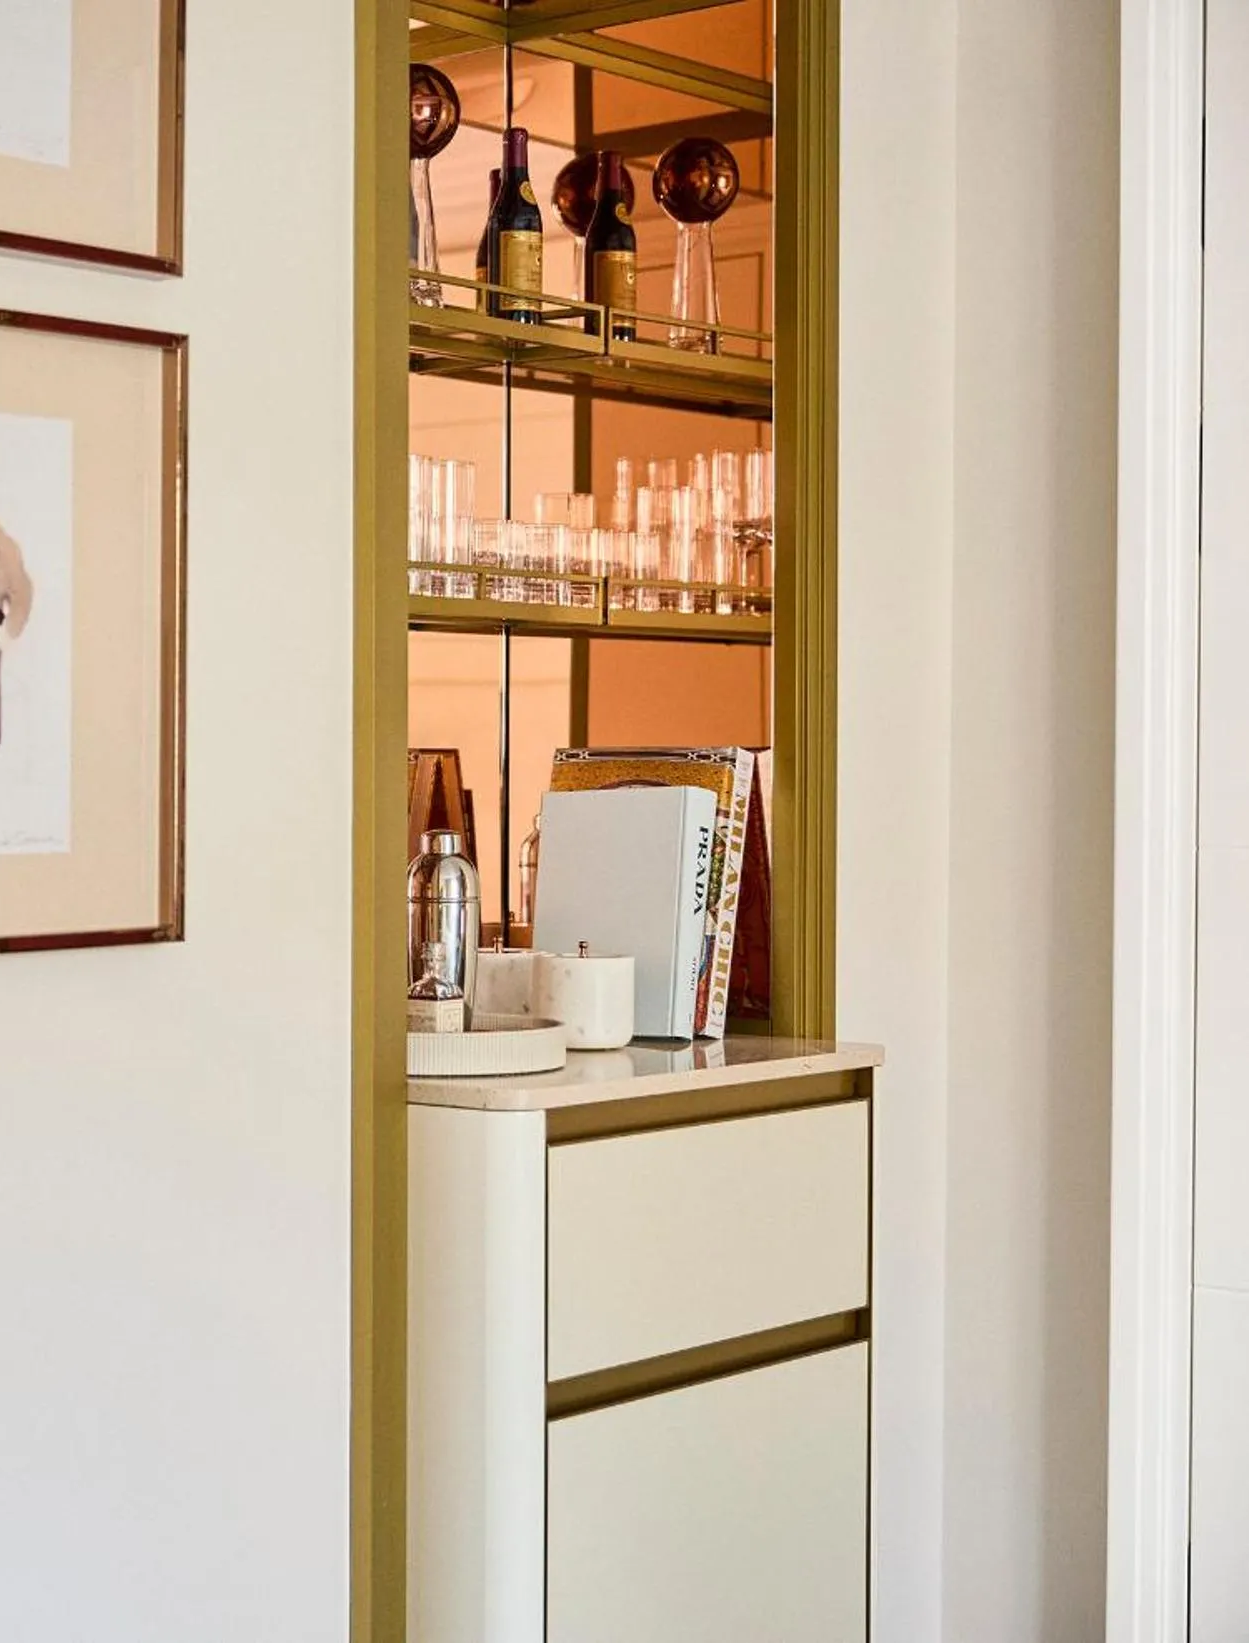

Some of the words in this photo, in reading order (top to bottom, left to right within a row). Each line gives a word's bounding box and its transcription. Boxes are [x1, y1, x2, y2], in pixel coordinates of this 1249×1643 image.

[693, 826, 709, 915] PRADA
[724, 790, 747, 912] MILAN
[710, 919, 731, 1015] CHIC
